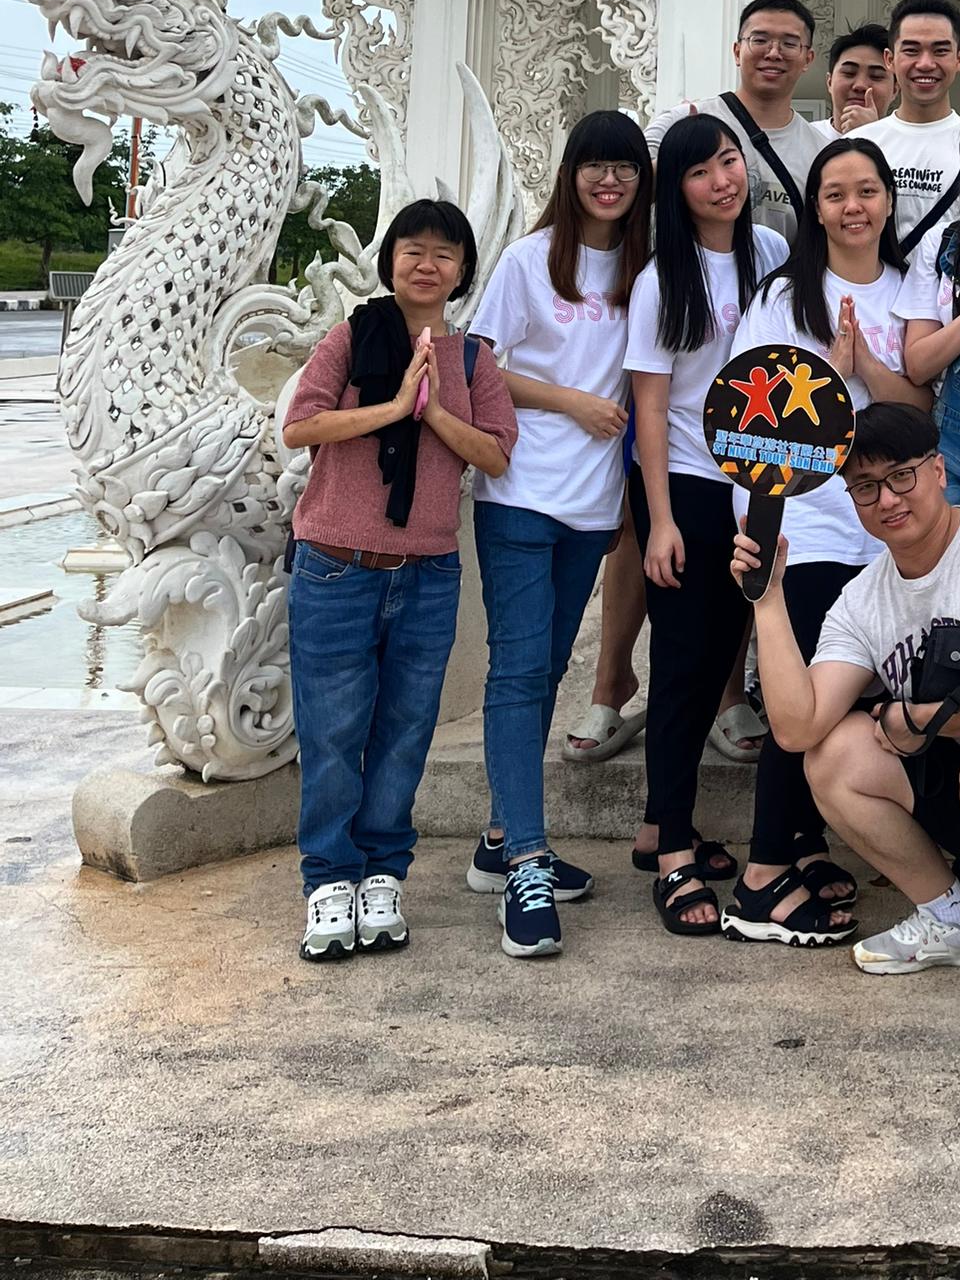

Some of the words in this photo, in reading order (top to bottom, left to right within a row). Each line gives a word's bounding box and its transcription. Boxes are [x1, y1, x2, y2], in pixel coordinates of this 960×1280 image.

[909, 180, 942, 193] COURAGE
[759, 449, 787, 466] TOUR
[789, 456, 812, 471] SDN
[811, 459, 836, 474] BHD
